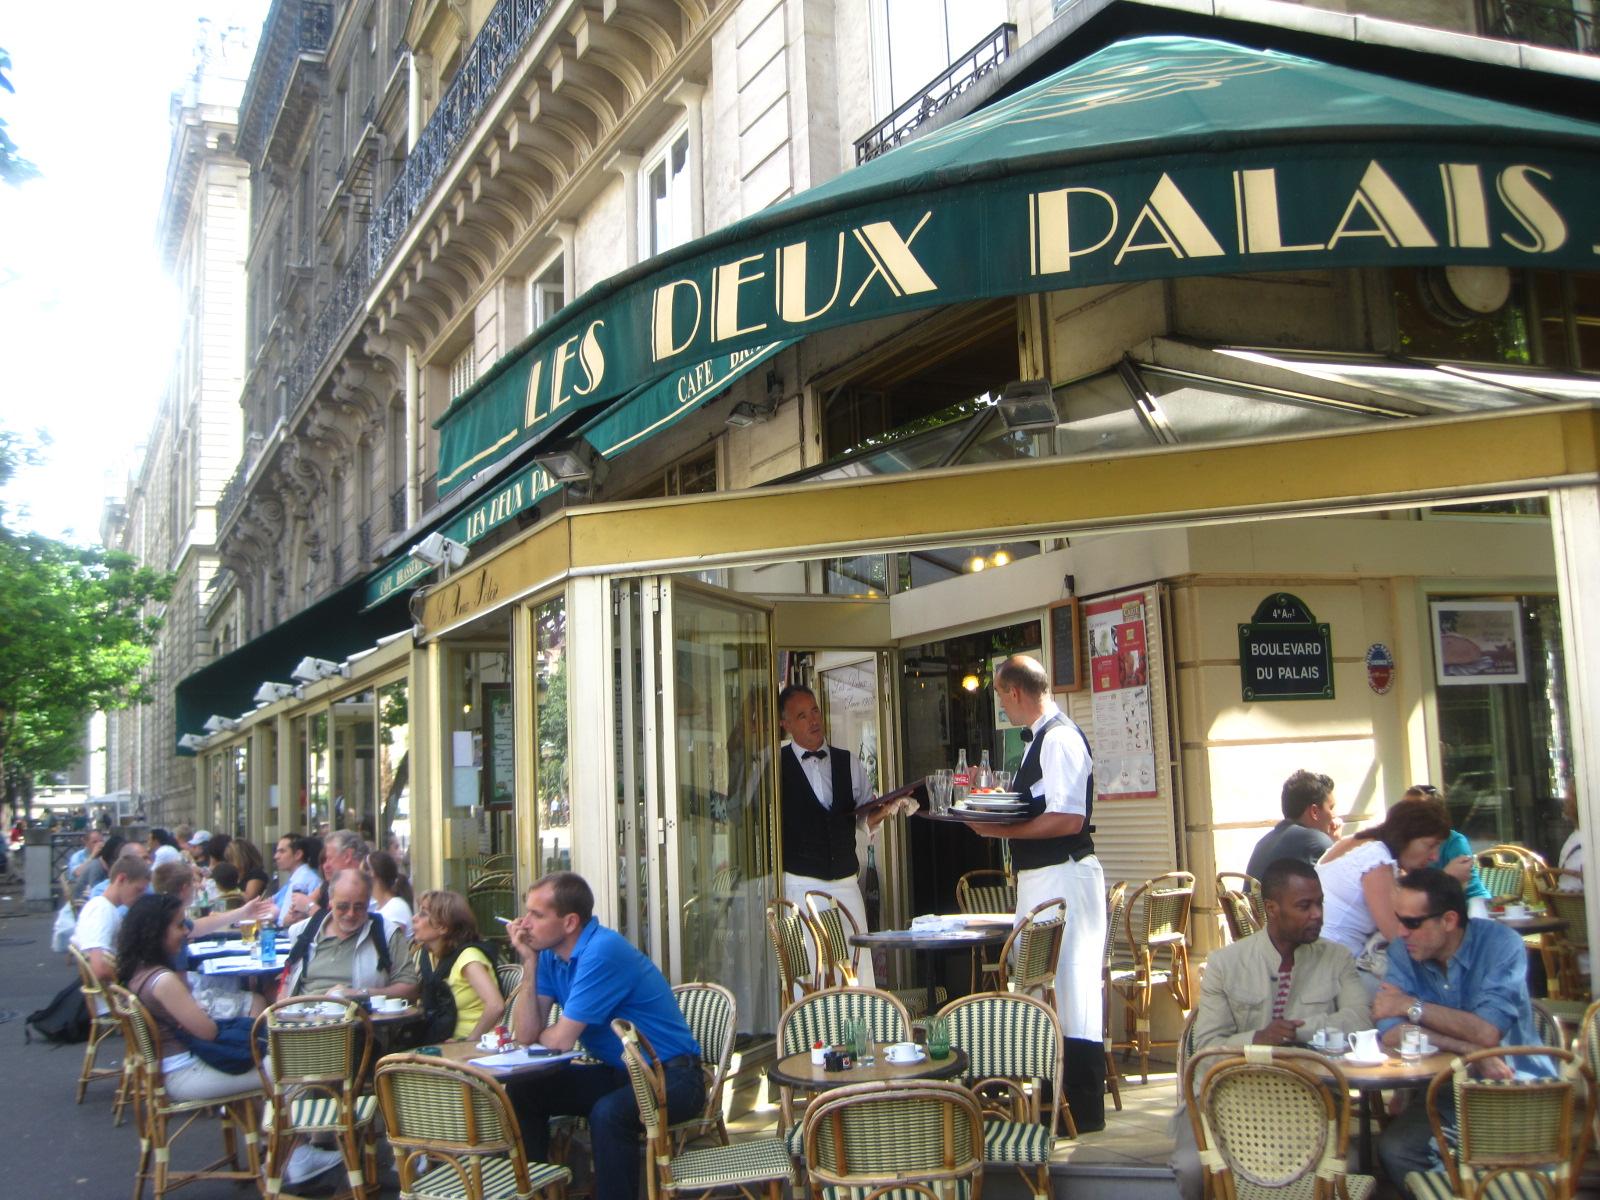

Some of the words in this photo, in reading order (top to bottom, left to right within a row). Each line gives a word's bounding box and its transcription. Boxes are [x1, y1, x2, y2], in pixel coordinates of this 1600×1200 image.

[525, 319, 605, 429] LES
[652, 211, 938, 363] DEUX
[1029, 159, 1568, 276] PALAIS
[677, 358, 714, 403] CAFE
[466, 505, 487, 541] LES
[489, 481, 523, 526] DEUX
[1250, 642, 1322, 656] BOULEVARD
[1256, 666, 1273, 680] DU
[1278, 666, 1320, 680] PALAIS
